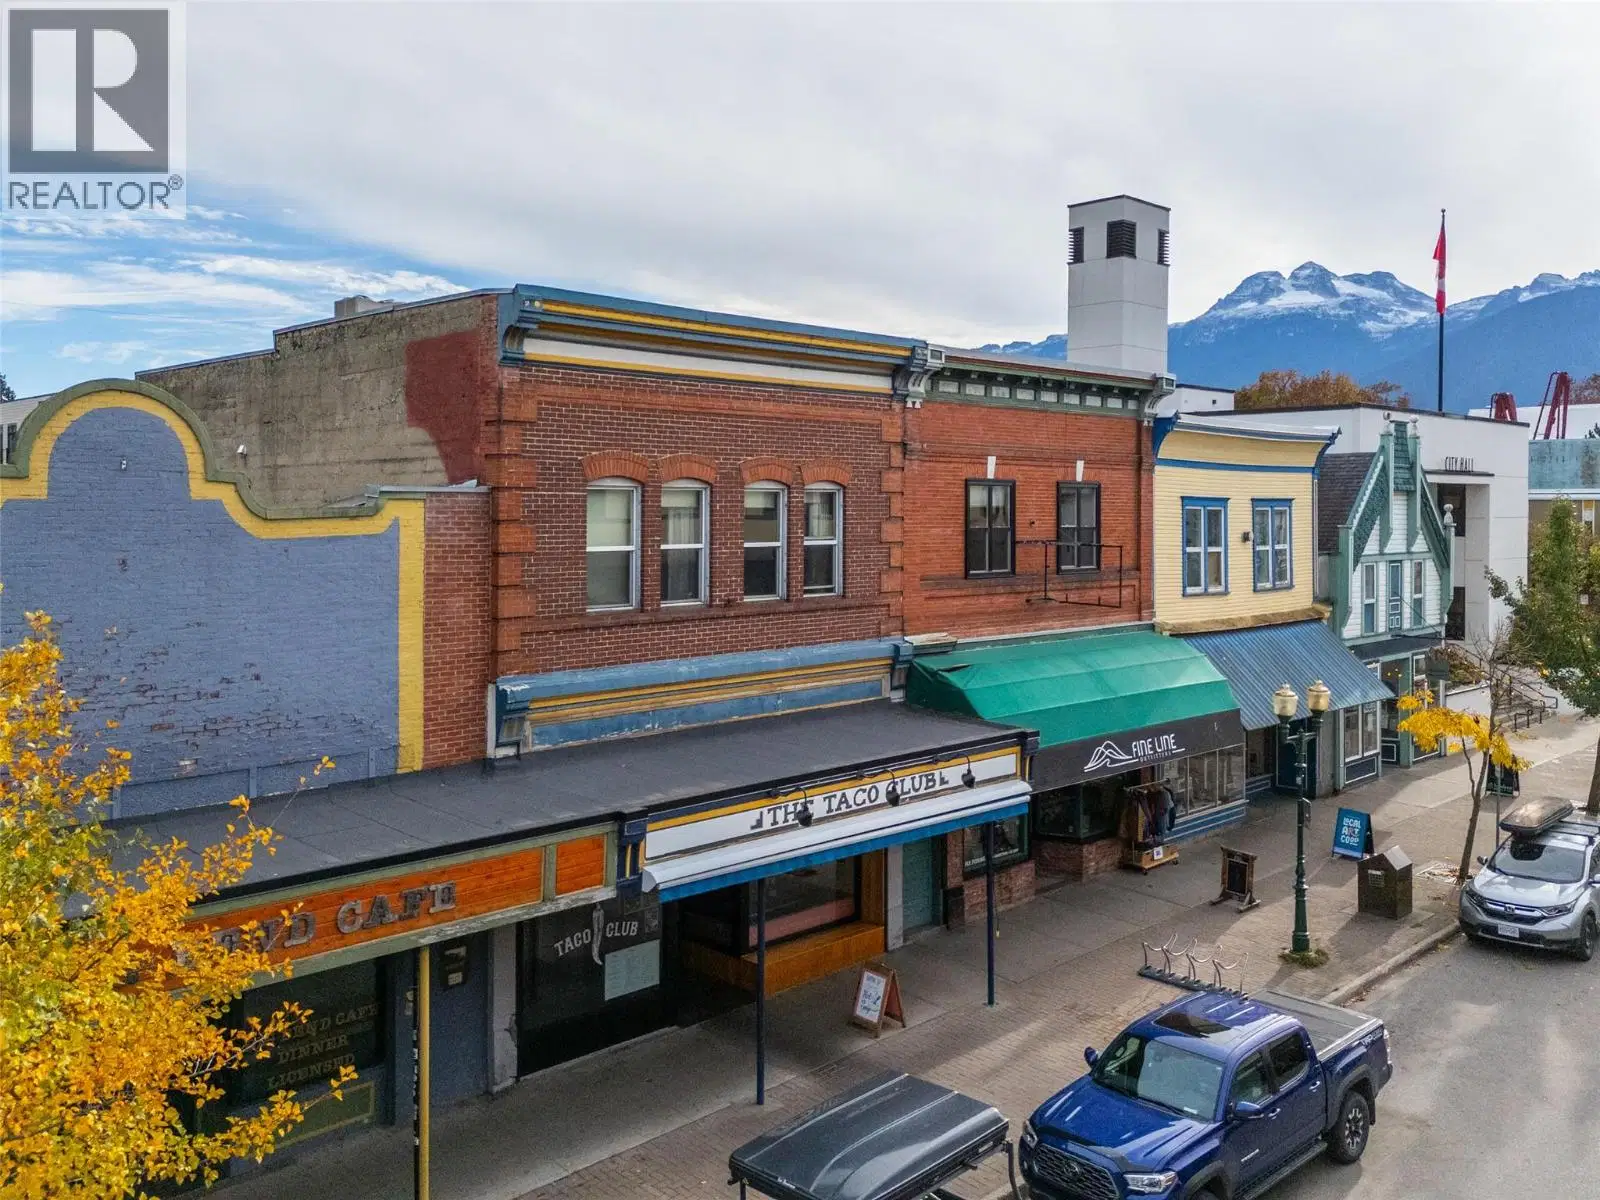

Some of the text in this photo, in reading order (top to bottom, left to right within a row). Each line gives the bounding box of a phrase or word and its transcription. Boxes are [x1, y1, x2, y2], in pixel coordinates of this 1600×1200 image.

[1444, 456, 1474, 472] CITY HALL
[1131, 733, 1177, 758] FINE LINE
[823, 784, 880, 814] TACO
[1341, 826, 1360, 837] ART
[336, 880, 456, 934] CAFE
[553, 921, 639, 957] TACO CLUB
[277, 1034, 350, 1064] DINNER
[267, 1052, 356, 1092] LICENSED
